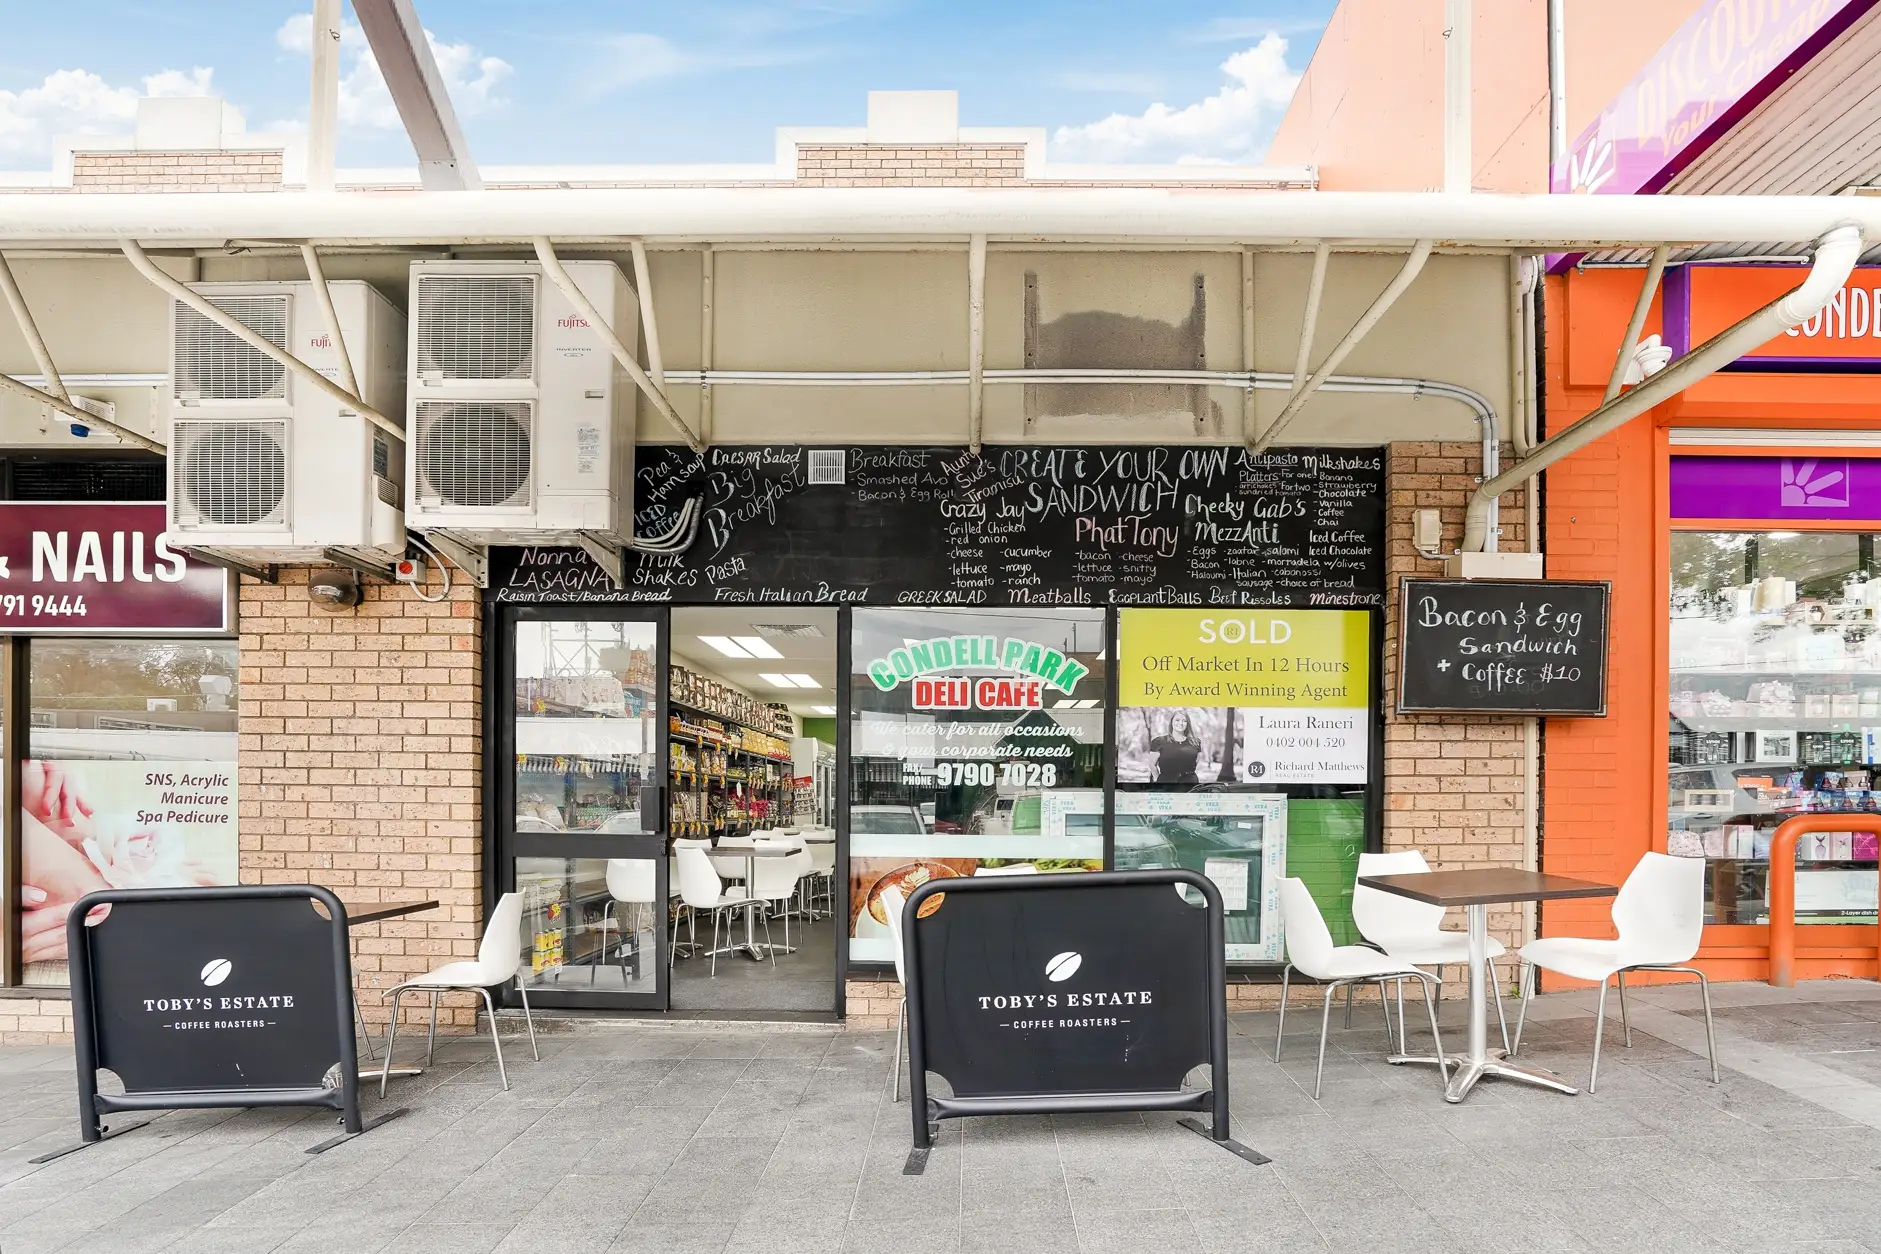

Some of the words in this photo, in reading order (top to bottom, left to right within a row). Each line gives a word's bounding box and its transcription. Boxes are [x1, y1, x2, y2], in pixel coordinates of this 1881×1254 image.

[1637, 0, 1802, 150] DISCOU
[762, 447, 802, 464] Salad
[850, 448, 931, 473] Breakfast
[940, 450, 981, 477] Aunty
[1233, 449, 1299, 471] Antipasto
[1302, 453, 1381, 476] Milkshakes
[637, 461, 672, 487] Pea
[956, 459, 997, 489] Sue's
[1000, 449, 1090, 489] CREATE
[1092, 447, 1174, 488] YOUR
[1178, 446, 1230, 488] OWN
[1239, 470, 1279, 482] Platters
[707, 466, 756, 508] Big
[921, 471, 949, 486] Avo
[647, 476, 687, 502] Ham
[910, 488, 931, 502] Egg
[962, 475, 1025, 503] Tiramisu
[1025, 480, 1179, 523] SANDWICH
[1184, 492, 1245, 523] Cheeky
[1253, 495, 1307, 520] Gab's
[703, 462, 806, 560] Breakfast
[940, 498, 986, 523] Crazy
[996, 497, 1025, 526] Jay
[987, 521, 1026, 534] Chicken
[1075, 517, 1129, 551] Phat
[1125, 513, 1179, 558] Tony
[1309, 531, 1329, 543] Iced
[1331, 530, 1366, 543] Coffee
[978, 534, 1008, 544] onion
[32, 531, 187, 583] NAILS
[1309, 545, 1328, 556] Iced
[1329, 545, 1373, 556] Chocolate
[705, 554, 747, 585] Pasta
[1324, 557, 1366, 570] w/olives
[632, 568, 699, 588] Shakes
[1235, 579, 1274, 591] sausage
[1310, 578, 1322, 588] of
[1324, 575, 1355, 588] bread
[496, 587, 535, 602] Raisin
[631, 588, 673, 602] Bread
[714, 587, 756, 603] Fresh
[759, 587, 812, 603] Italian
[815, 581, 869, 604] Bread
[1008, 587, 1092, 604] Meatballs
[1310, 590, 1381, 605] Minestrone
[0, 594, 25, 616] 91
[32, 595, 87, 616] 9444
[1418, 596, 1507, 628] Bacon
[1535, 603, 1582, 637] Egg
[1199, 619, 1292, 644] SOLD
[1459, 633, 1578, 656] Sandwich
[868, 635, 999, 691] CONDELL
[1001, 637, 1089, 696] PARK
[1142, 656, 1173, 672] Off
[1177, 656, 1240, 672] Market
[1246, 657, 1263, 672] In
[1271, 657, 1289, 672] 12
[1296, 658, 1350, 673] Hours
[1437, 659, 1452, 673] +
[1461, 663, 1527, 693] Coffee
[1540, 663, 1581, 684] $10
[913, 678, 970, 708] DELI
[975, 679, 1043, 709] CAFE
[1144, 682, 1164, 700] By
[1169, 682, 1221, 696] Award
[1226, 682, 1296, 700] Winning
[1301, 683, 1347, 700] Agent
[870, 722, 898, 736] We
[900, 724, 945, 736] cater
[945, 722, 975, 740] for
[978, 722, 1002, 736] all
[1004, 723, 1085, 736] occasions
[1259, 715, 1301, 730] Laura
[1306, 716, 1354, 730] Raneri
[898, 745, 934, 760] your
[935, 744, 1023, 759] corporate
[1021, 743, 1073, 757] needs
[1266, 737, 1295, 748] 0402
[1298, 738, 1321, 748] 004
[1323, 737, 1346, 748] 520
[938, 763, 995, 787] 9790
[999, 763, 1057, 787] 7028
[1275, 761, 1314, 771] Richard
[1318, 761, 1365, 771] Matthews
[145, 773, 177, 788] SNS,
[181, 773, 229, 789] Acrylic
[903, 776, 932, 786] PHONE
[161, 792, 229, 805] Manicure
[136, 810, 163, 825] Spa
[167, 810, 229, 824] Pedicure
[221, 995, 295, 1009] ESTATE
[1067, 991, 1153, 1007] ESTATE
[175, 1021, 210, 1030] COFFEE
[214, 1020, 265, 1029] ROASTERS
[1013, 1020, 1054, 1029] COFFEE
[1059, 1018, 1117, 1028] ROASTERS
